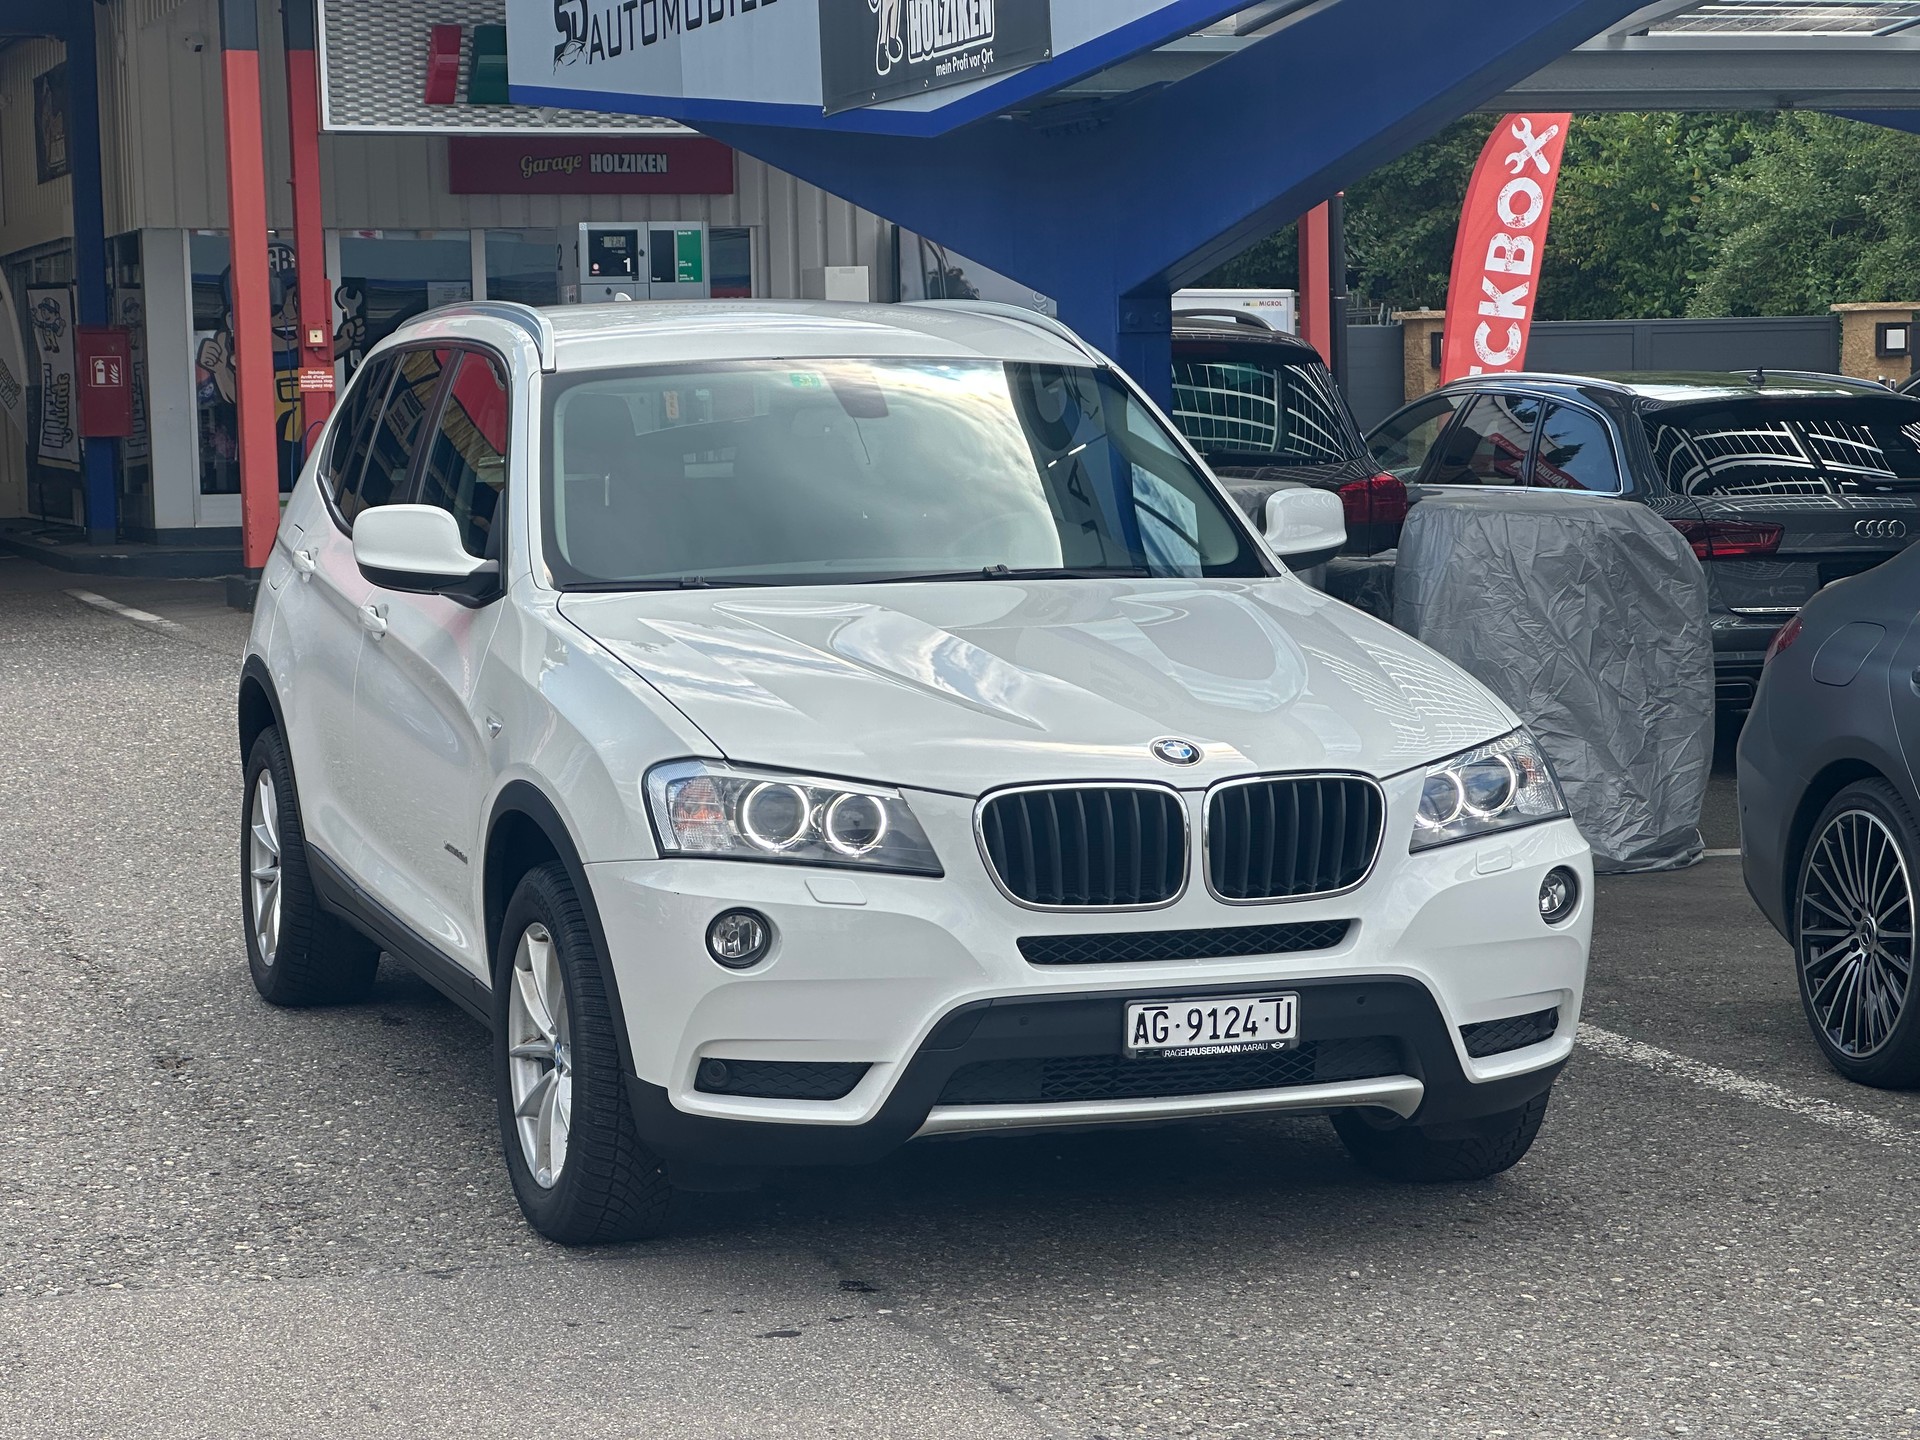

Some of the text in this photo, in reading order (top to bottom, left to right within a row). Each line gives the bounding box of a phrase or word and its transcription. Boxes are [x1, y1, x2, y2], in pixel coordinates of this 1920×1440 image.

[909, 0, 993, 55] HOLZIKEN
[935, 48, 994, 77] mein Profi vor Ort
[520, 154, 668, 178] Garage HOLZIKEN
[623, 257, 631, 273] 1
[1242, 1043, 1268, 1052] AARAU
